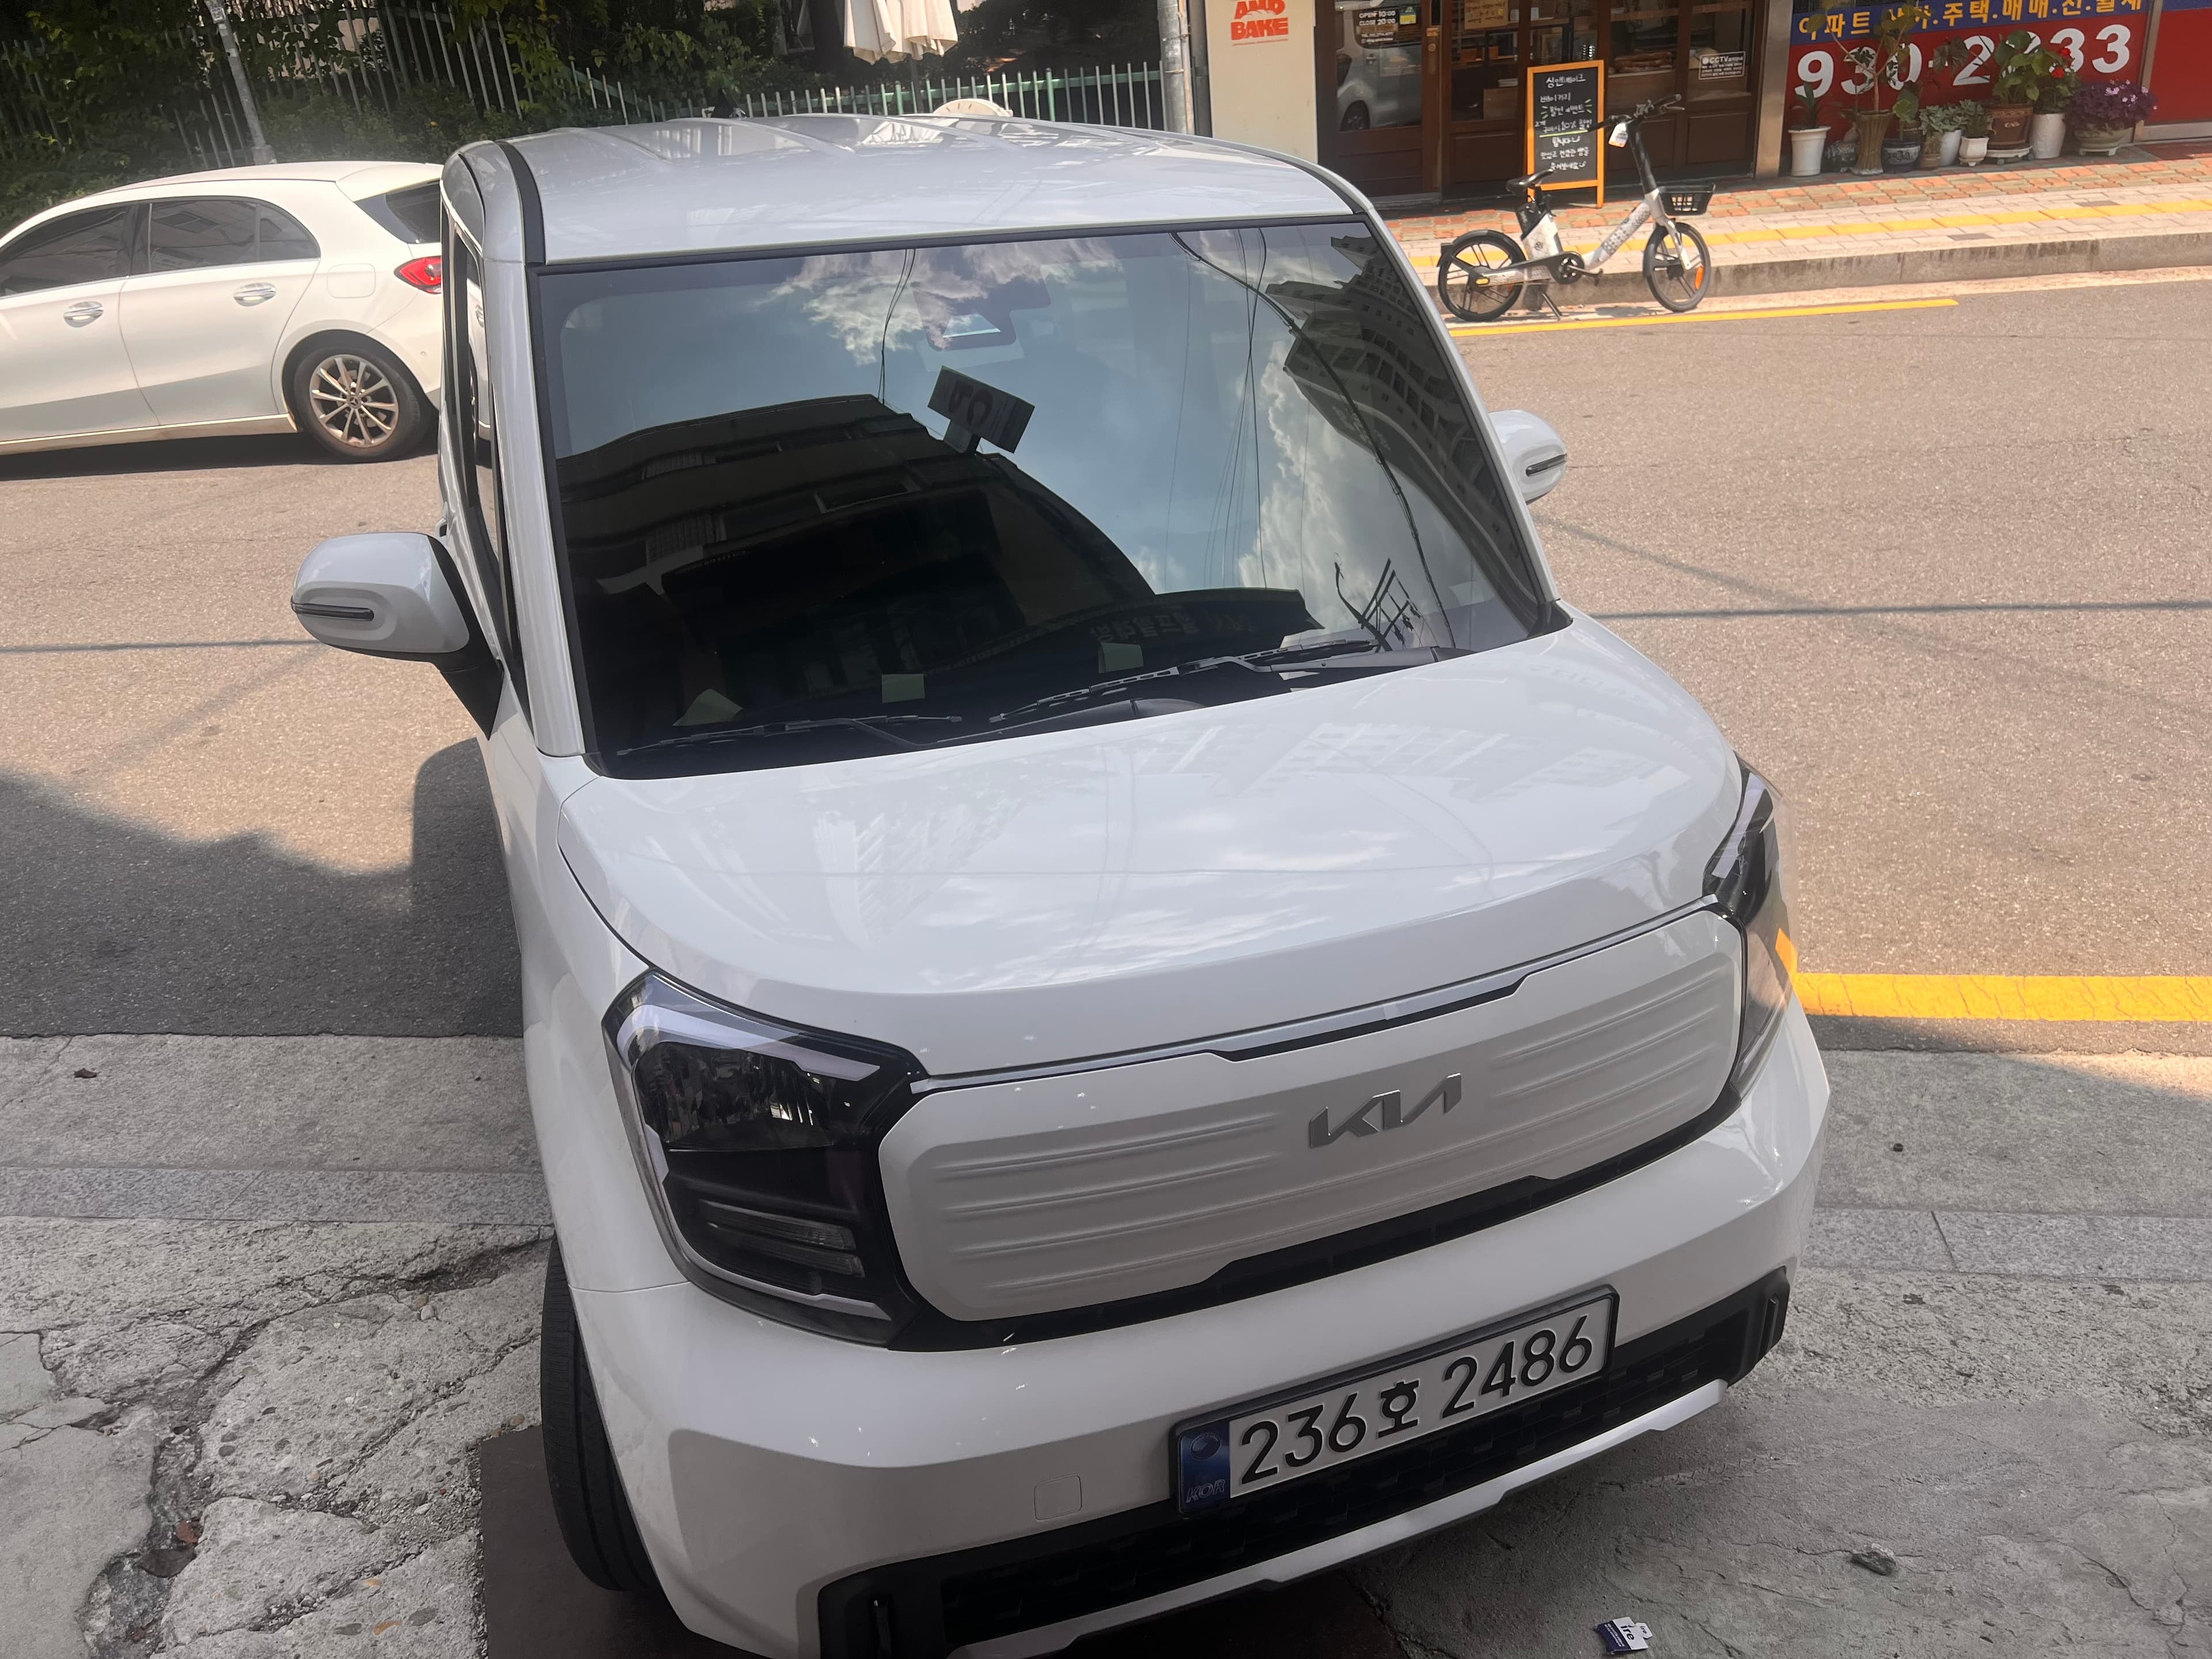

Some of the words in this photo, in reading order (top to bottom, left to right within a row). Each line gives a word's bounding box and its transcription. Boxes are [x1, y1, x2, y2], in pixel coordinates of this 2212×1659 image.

[1230, 17, 1289, 40] BAKE
[1709, 55, 1729, 64] CCTV
[1561, 120, 1577, 131] 10%
[1308, 1072, 1463, 1148] KIA
[1441, 1316, 1593, 1420] 2486
[1185, 1479, 1226, 1503] KOR
